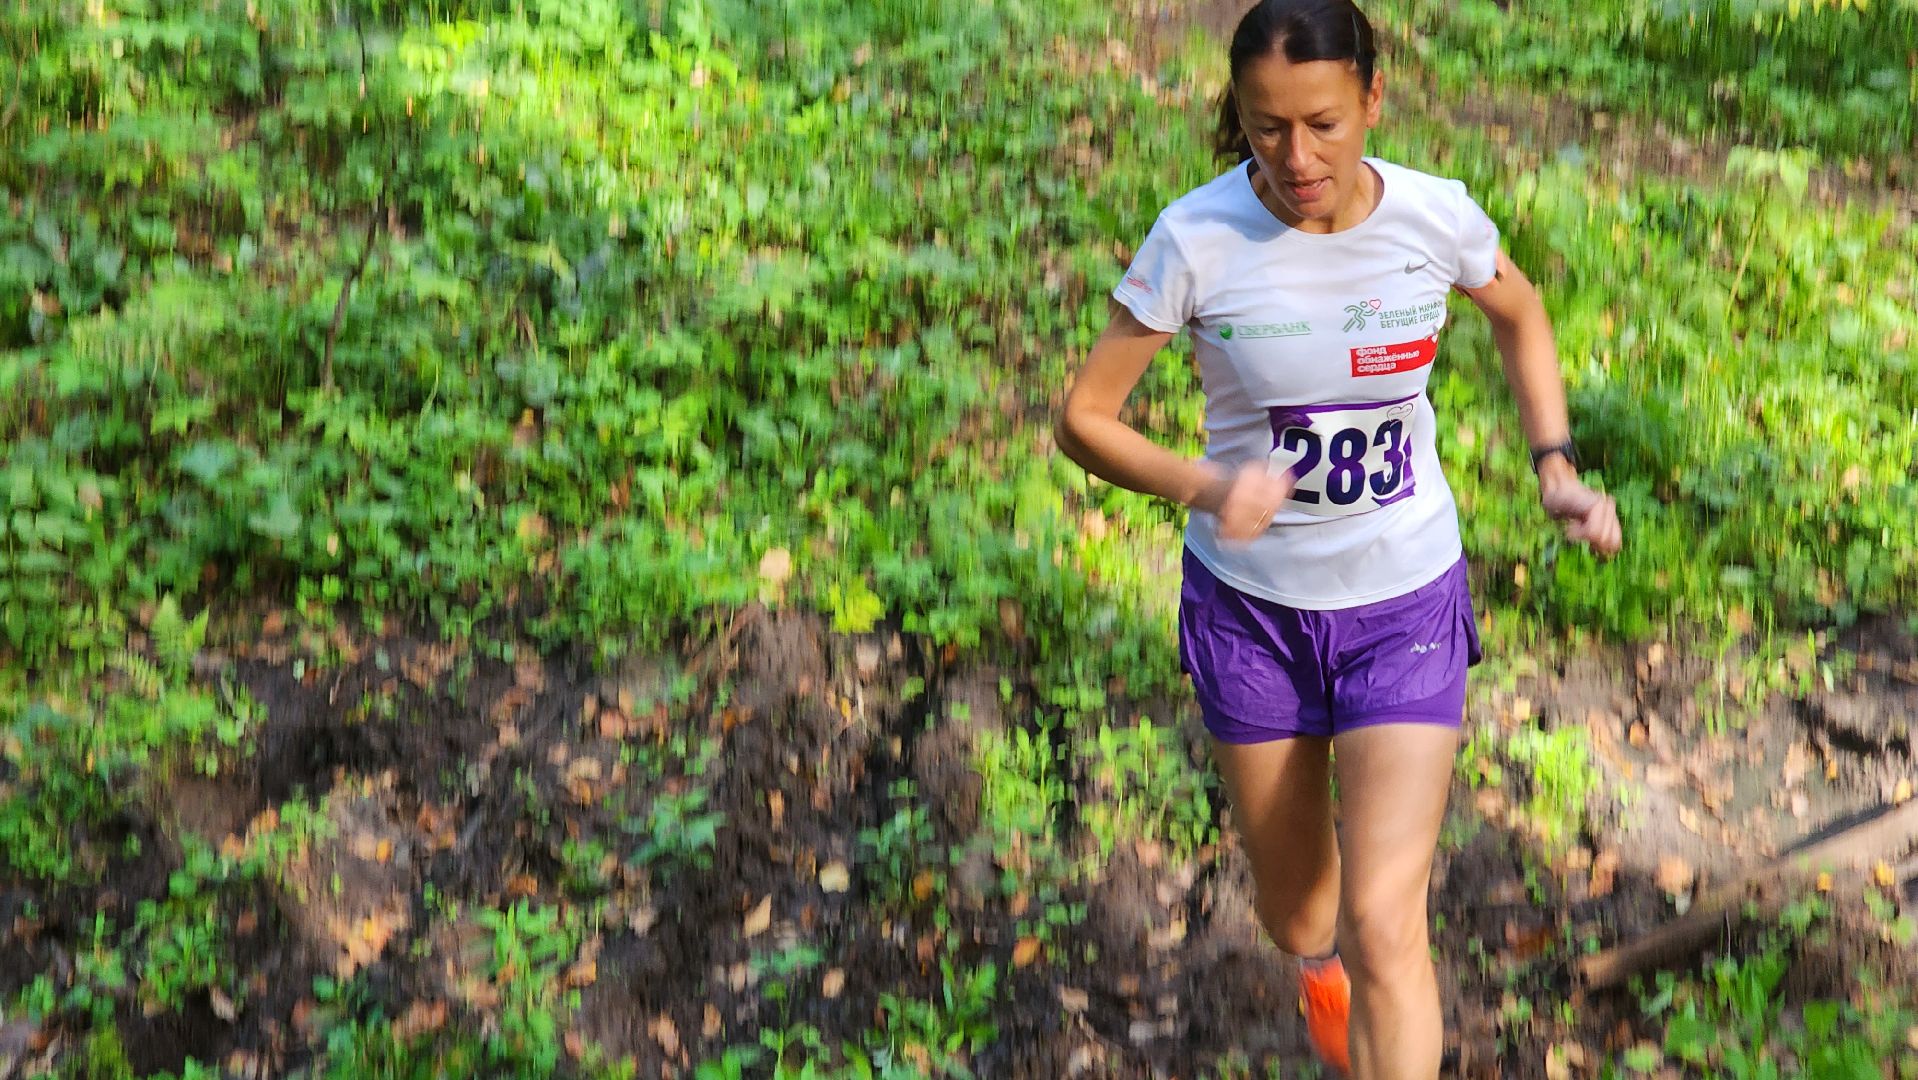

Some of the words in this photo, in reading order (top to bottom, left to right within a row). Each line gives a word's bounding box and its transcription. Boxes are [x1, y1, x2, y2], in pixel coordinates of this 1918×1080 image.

[1379, 305, 1417, 320] ЗЕЛЕНЫЙ
[1380, 316, 1418, 329] БЕГУЩИЕ
[1357, 362, 1397, 372] сердца
[1283, 419, 1404, 505] 283
